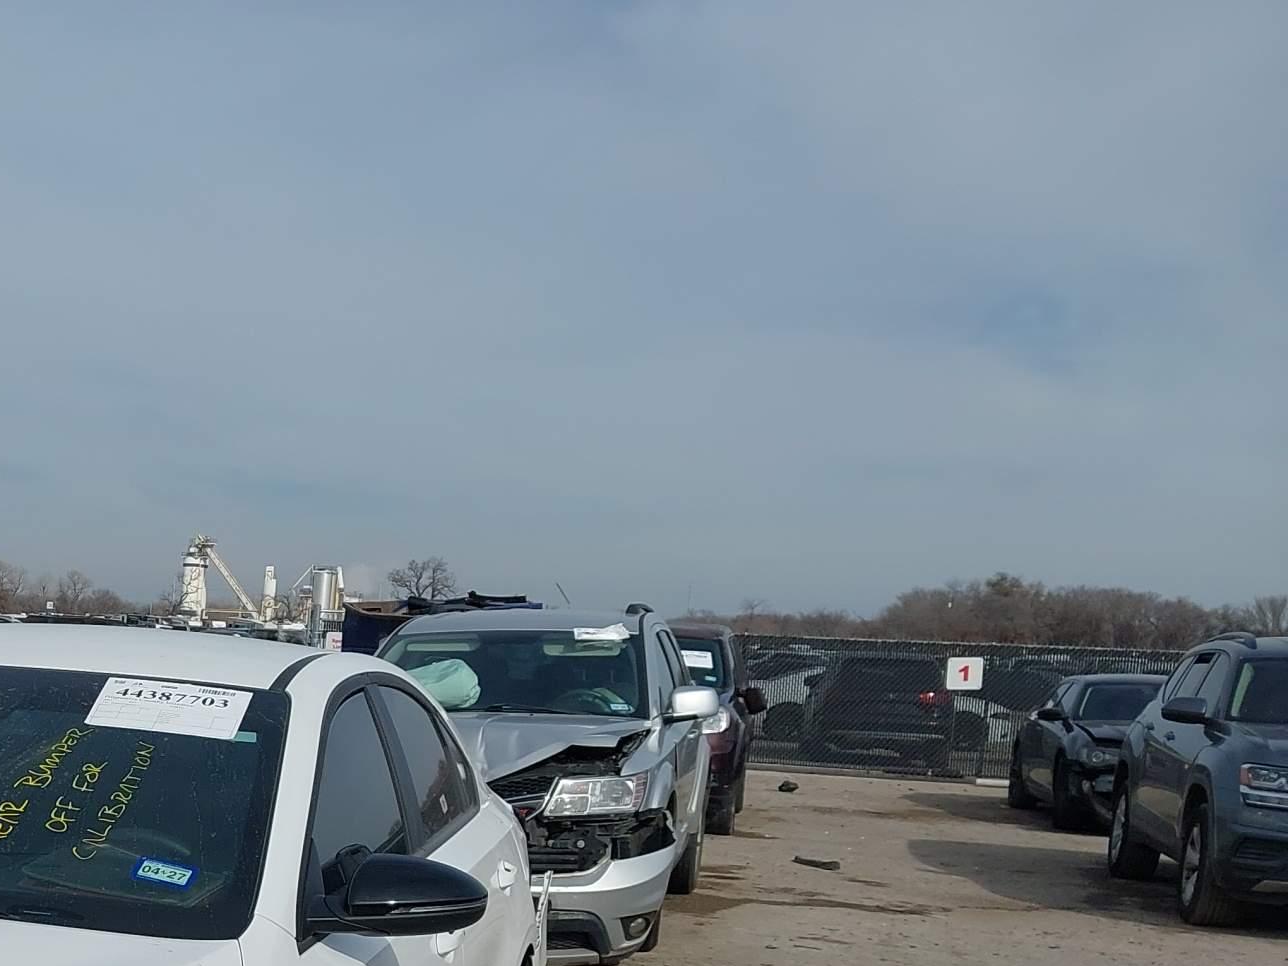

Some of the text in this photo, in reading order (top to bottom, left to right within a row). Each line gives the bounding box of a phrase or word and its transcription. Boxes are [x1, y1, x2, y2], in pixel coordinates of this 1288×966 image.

[115, 687, 230, 709] 44387703
[958, 665, 970, 682] 1
[13, 727, 95, 789] BUMPER
[45, 761, 109, 833] OFF FOR
[72, 741, 156, 860] CALIBRATION
